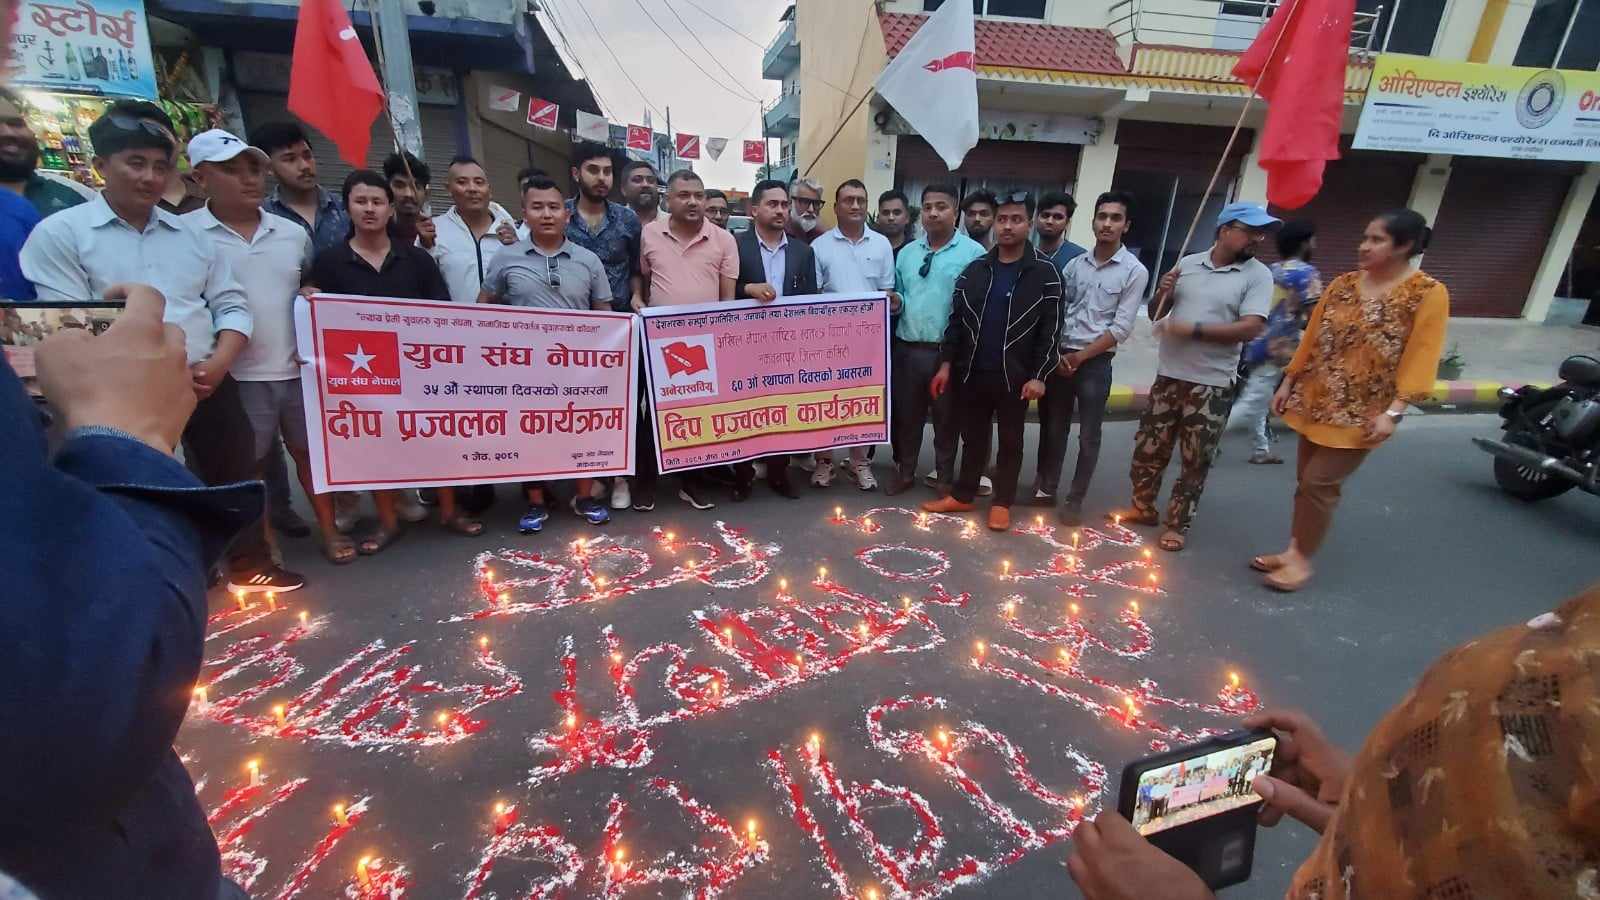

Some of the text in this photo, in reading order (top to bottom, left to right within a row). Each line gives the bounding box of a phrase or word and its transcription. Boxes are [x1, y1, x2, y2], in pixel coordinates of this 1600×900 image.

[1379, 68, 1463, 98] ओरिएण्टल
[1578, 89, 1600, 112] Or
[717, 332, 743, 349] अखिल
[745, 330, 768, 345] नेपाल
[402, 342, 626, 369] युवा संघ नेपाल
[328, 375, 400, 387] युवा संघ नेपाल
[423, 384, 440, 396] ३५
[463, 384, 508, 396] स्थापना
[512, 382, 560, 396] दिवसको
[562, 385, 609, 397] अवसरमा
[731, 379, 743, 392] ६०
[762, 369, 795, 387] स्थापना
[799, 366, 833, 384] दिवसको
[837, 365, 873, 381] अवसरमा
[327, 399, 625, 442] दीप प्रज्वलन कार्यक्रम
[664, 394, 881, 442] दिप प्रज्वलन कार्यक्रम
[462, 453, 468, 461] १
[495, 451, 519, 462] २०८१
